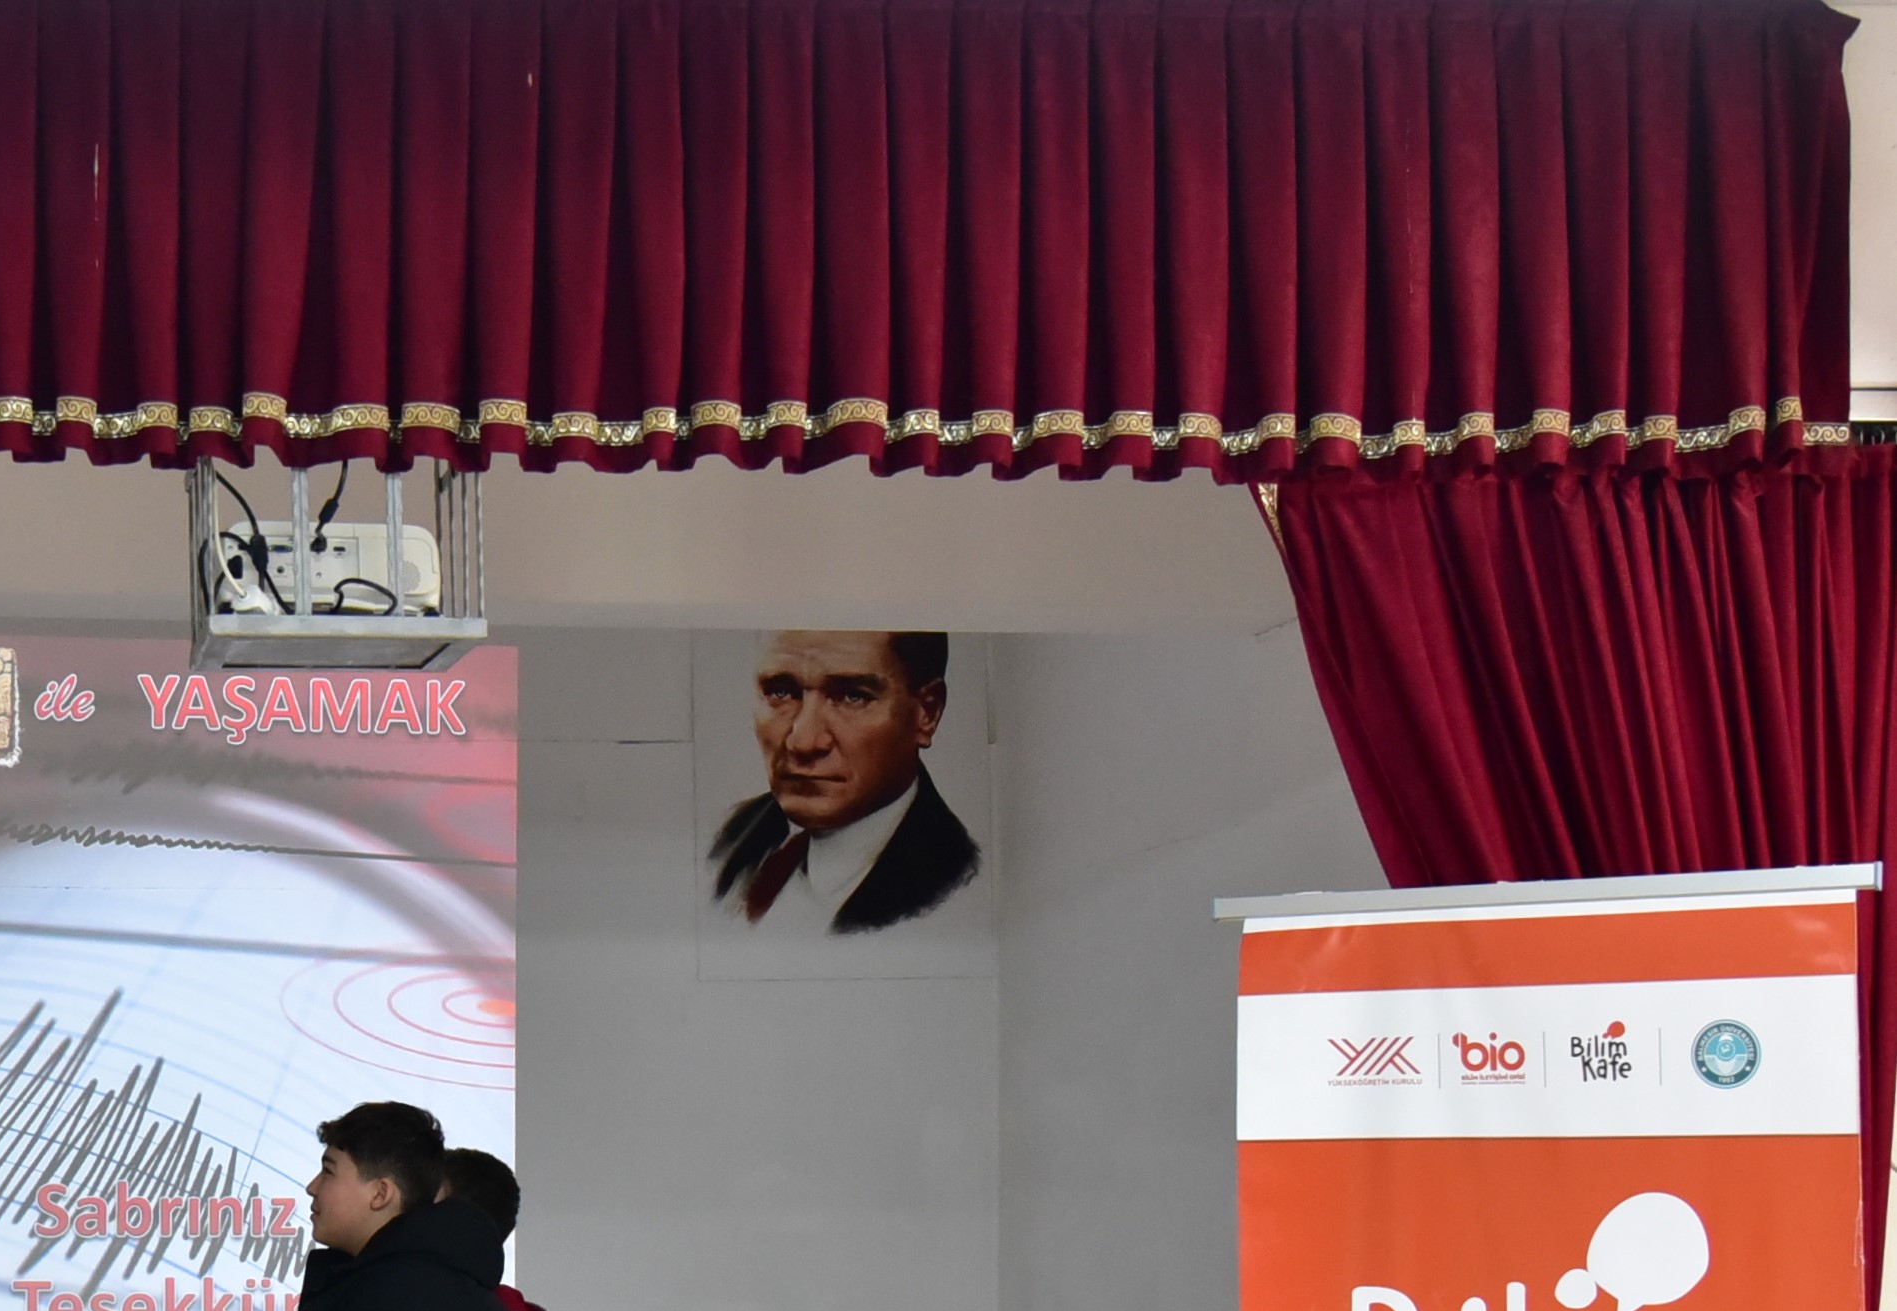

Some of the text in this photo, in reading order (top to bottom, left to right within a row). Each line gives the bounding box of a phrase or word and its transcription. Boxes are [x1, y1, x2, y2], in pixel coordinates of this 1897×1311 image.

[33, 673, 96, 723] ile
[138, 673, 467, 745] YAŞAMAK
[1452, 1032, 1525, 1071] bio
[1570, 1033, 1627, 1058] Bilim
[1581, 1053, 1632, 1082] Kafe
[34, 1180, 297, 1239] Sabrınız
